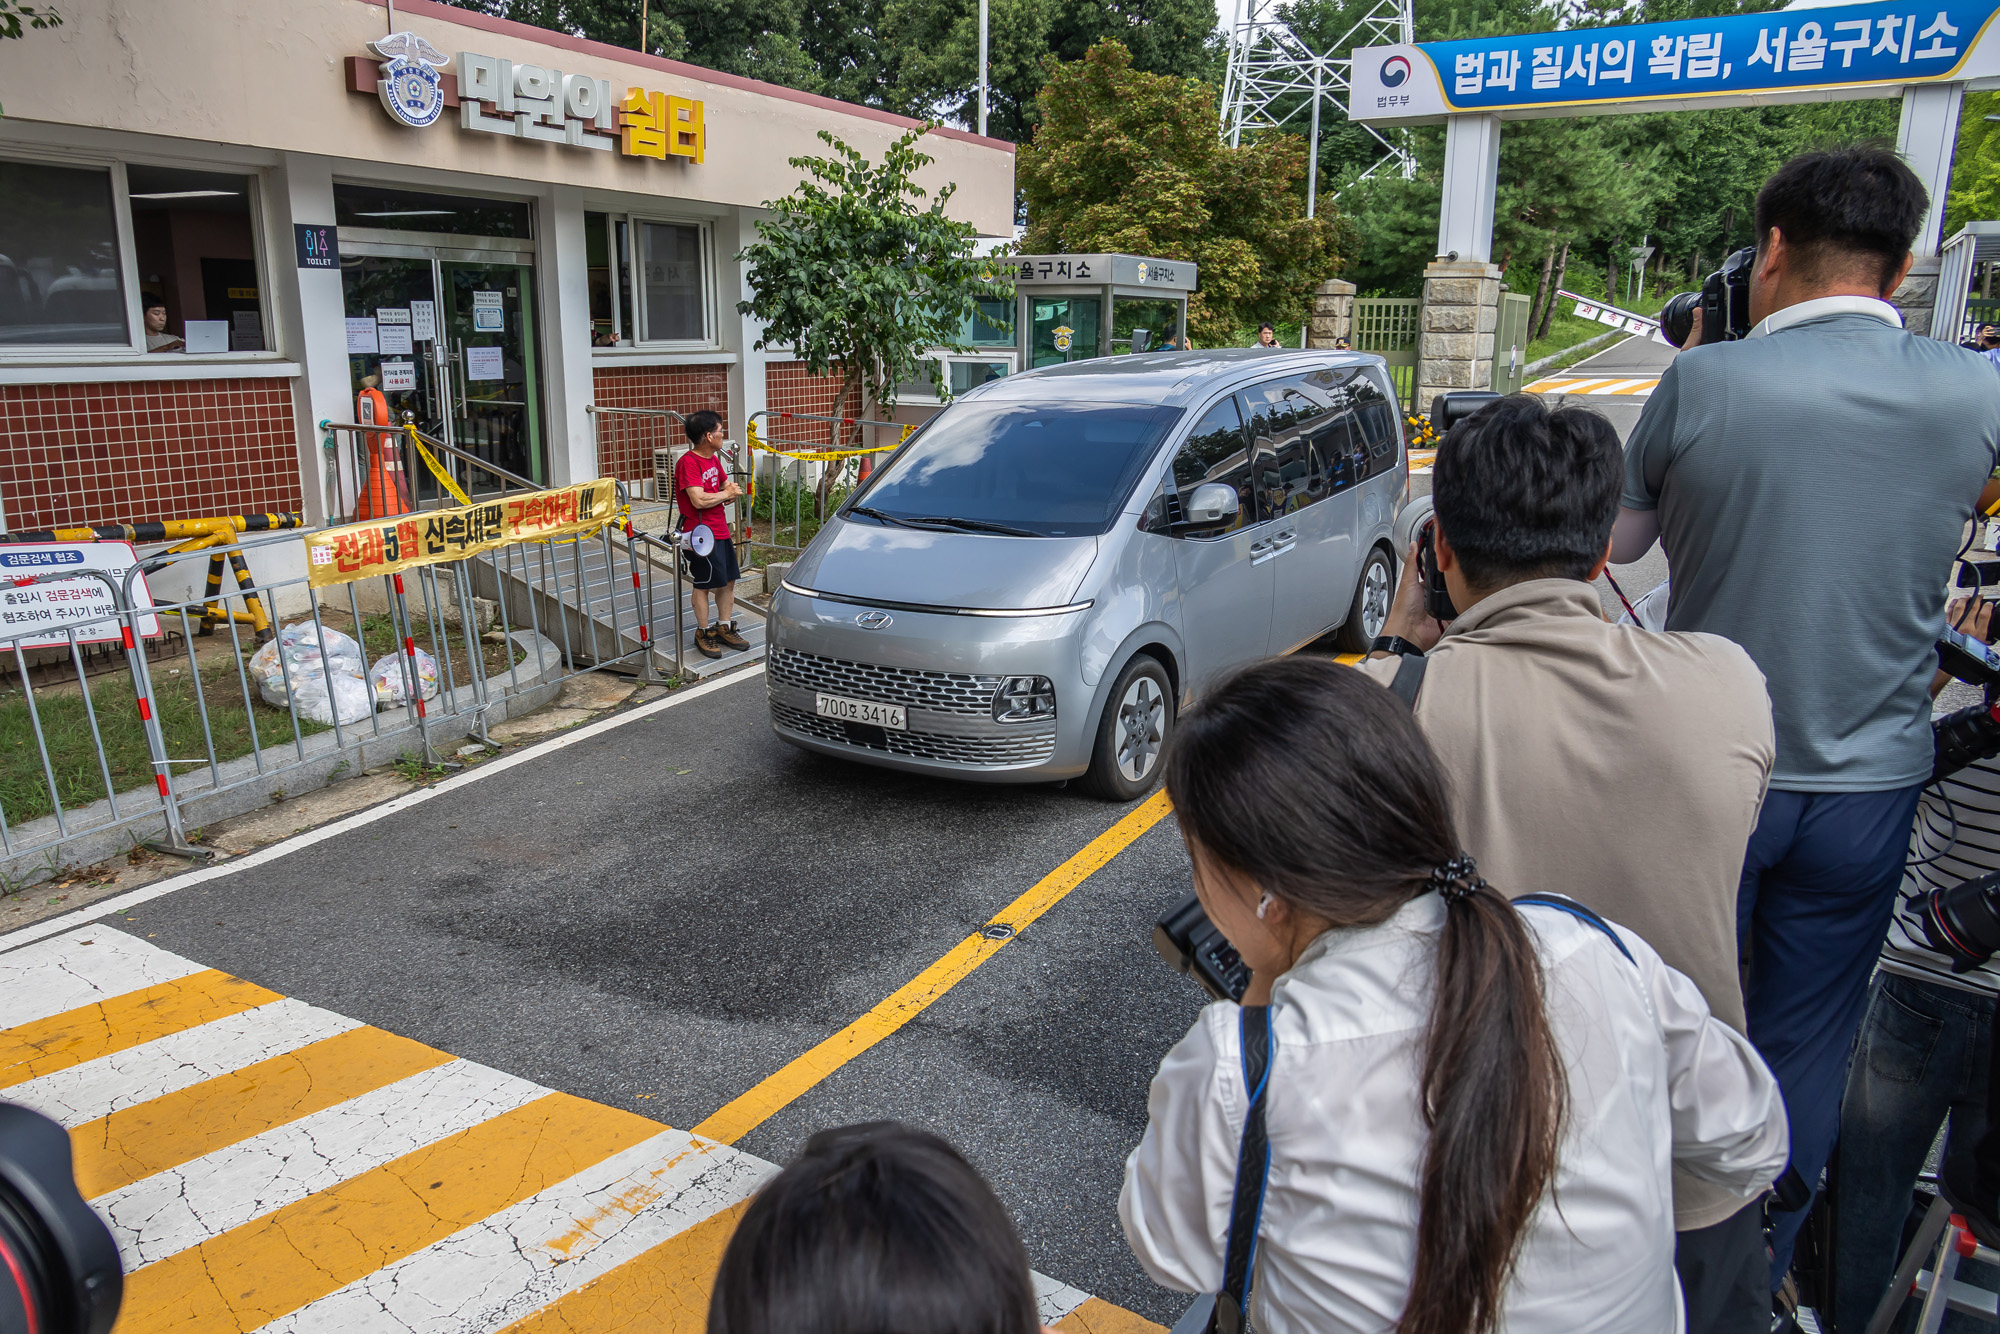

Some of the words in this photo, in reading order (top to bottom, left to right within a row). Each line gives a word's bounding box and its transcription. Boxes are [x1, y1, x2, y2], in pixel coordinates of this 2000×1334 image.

[1455, 50, 1522, 95] 법과
[1531, 39, 1636, 90] 질서의
[1648, 32, 1732, 81] 확립,
[1747, 11, 1959, 73] 서울구치소
[456, 52, 613, 151] 민원인
[619, 87, 704, 165] 쉼터
[1377, 94, 1410, 108] 법무부
[306, 258, 331, 266] TOILET
[1147, 266, 1175, 283] 서울구치소
[332, 520, 419, 574] 전과5범
[425, 504, 503, 555] 신속재판
[7, 553, 53, 566] 검문검색
[54, 551, 78, 563] 협조
[4, 591, 42, 605] 출입시
[45, 587, 104, 602] 검문검색에
[2, 608, 52, 624] 협조하여
[55, 606, 91, 620] 주시기
[820, 697, 858, 719] 700호
[861, 705, 900, 726] 3416
